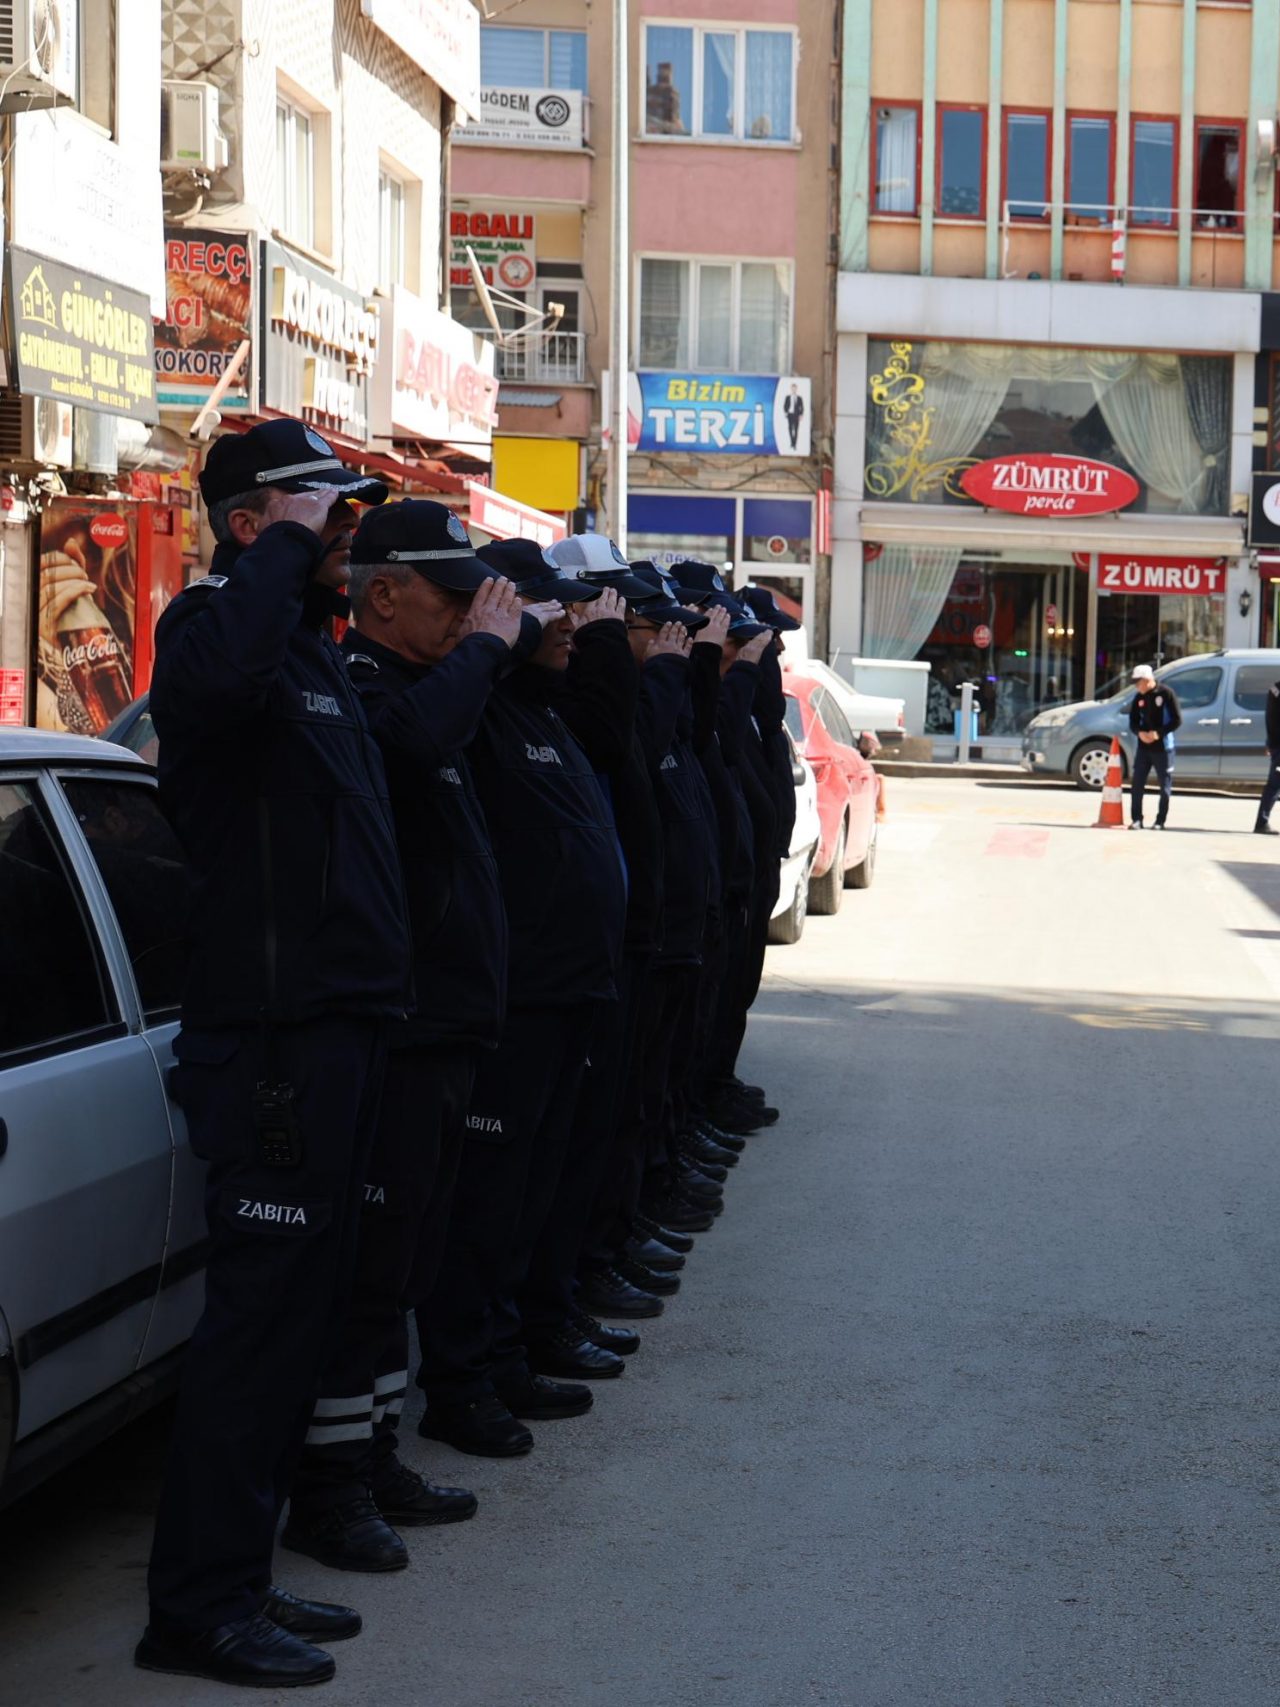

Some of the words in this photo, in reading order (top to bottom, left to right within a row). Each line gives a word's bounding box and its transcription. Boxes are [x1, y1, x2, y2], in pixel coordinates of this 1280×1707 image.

[61, 281, 148, 356] GÜNGÖRLER
[667, 379, 746, 402] Bizim
[648, 404, 765, 448] TERZİ
[992, 461, 1109, 493] ZÜMRÜT
[1024, 493, 1076, 511] perde
[1104, 562, 1220, 590] ZÜMRÜT
[237, 1199, 307, 1225] ZABITA
